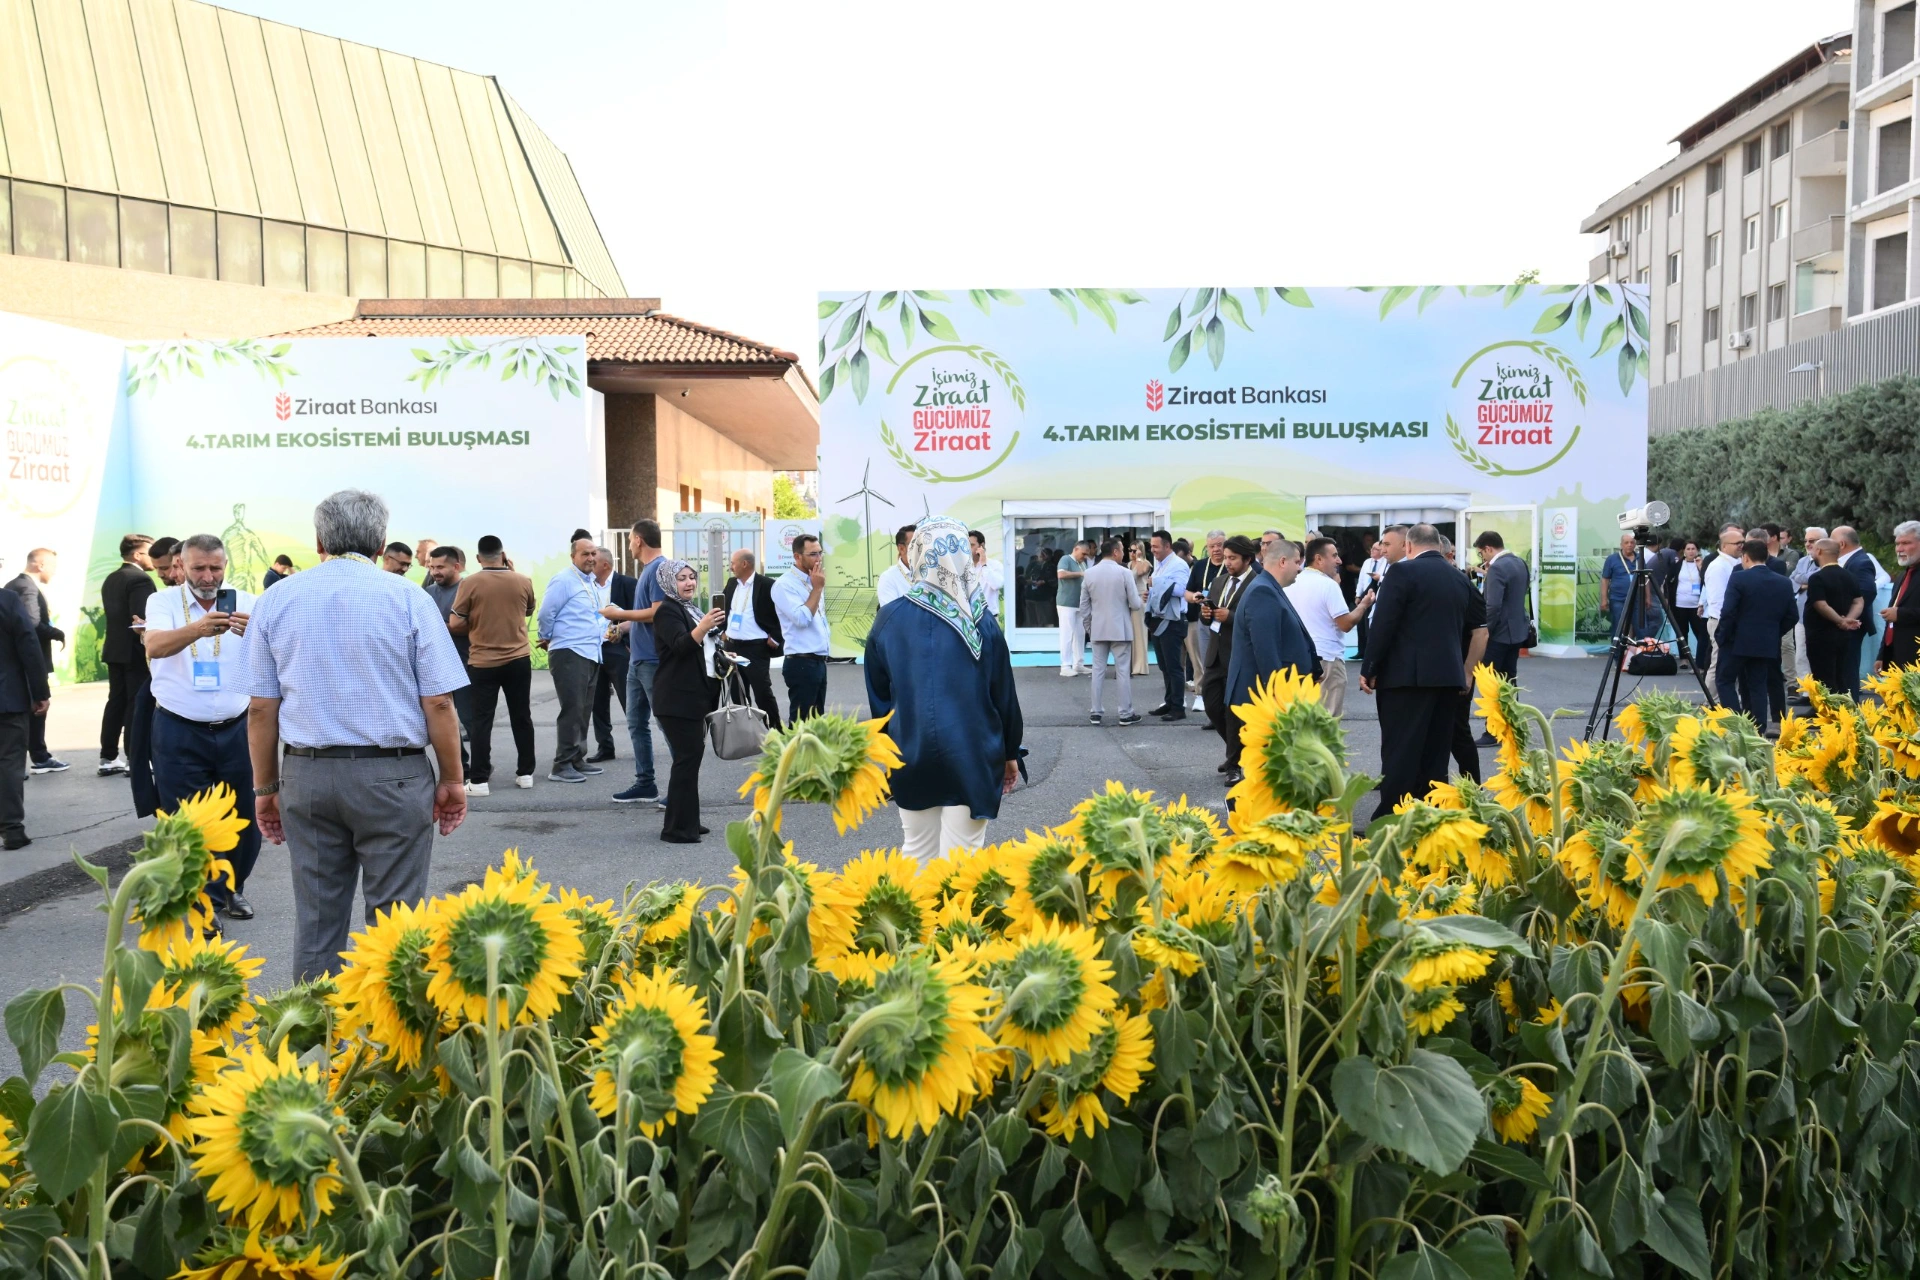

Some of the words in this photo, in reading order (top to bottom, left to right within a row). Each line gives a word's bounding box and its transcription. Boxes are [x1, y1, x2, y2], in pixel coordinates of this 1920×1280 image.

[932, 367, 977, 388] İşimiz
[1496, 362, 1540, 383] İşimiz
[913, 379, 991, 407] Ziraat
[1168, 386, 1236, 405] Ziraat
[1242, 386, 1327, 404] Bankası
[1478, 375, 1553, 401] Ziraat
[295, 398, 356, 415] Ziraat
[361, 398, 437, 415] Bankası
[913, 405, 991, 430] GÜCÜMÜZ
[1477, 400, 1553, 423] GÜCÜMÜZ
[185, 433, 271, 449] 4.TARIM
[276, 427, 400, 447] EKOSİSTEMİ
[407, 430, 530, 450] BULUŞMASI
[914, 430, 991, 451] Ziraat
[1043, 425, 1139, 442] 4.TARIM
[1146, 417, 1285, 441] EKOSİSTEMİ
[1293, 421, 1428, 443] BULUŞMASI
[1478, 424, 1552, 445] Ziraat
[8, 455, 70, 483] Ziraat
